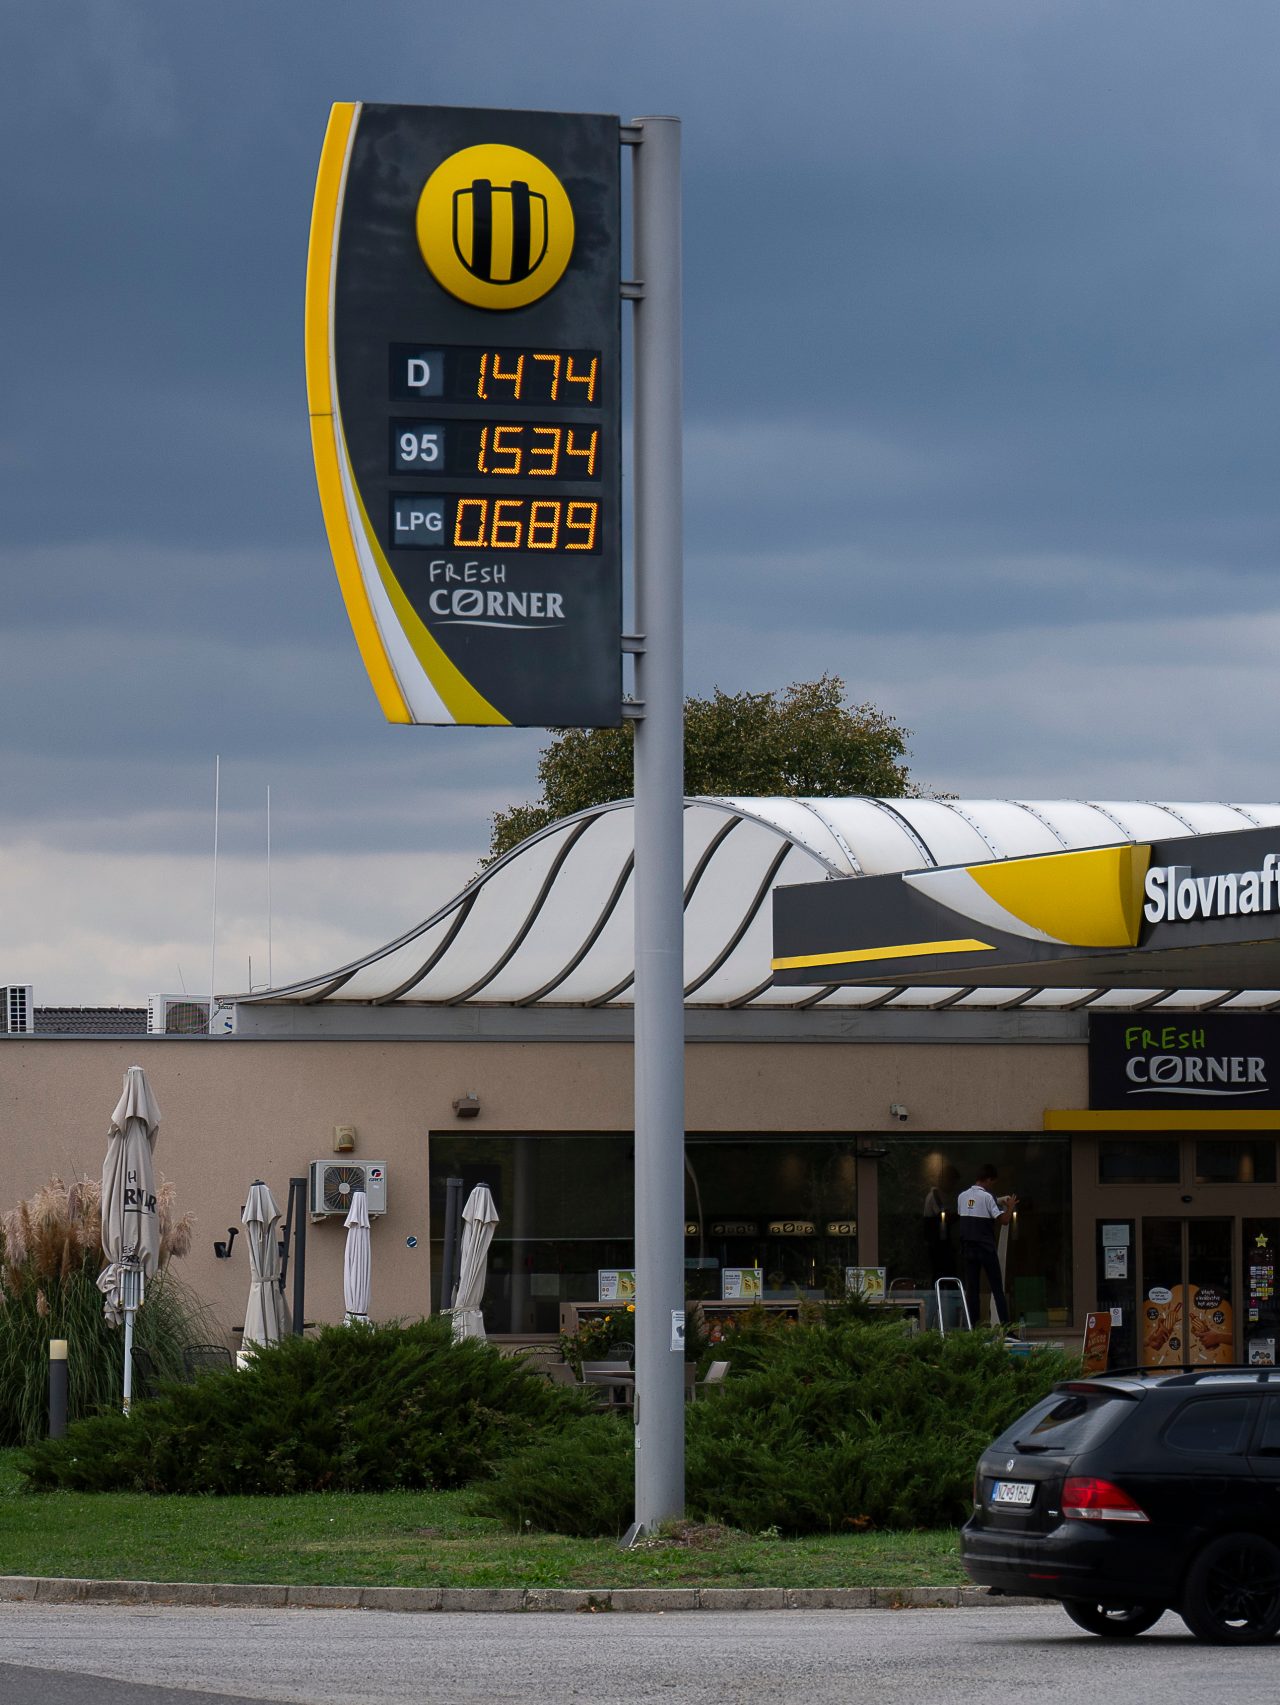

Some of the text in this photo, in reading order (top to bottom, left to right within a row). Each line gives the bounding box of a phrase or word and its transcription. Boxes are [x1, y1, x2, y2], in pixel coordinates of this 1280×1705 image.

[407, 353, 598, 402] D 1.474
[400, 426, 598, 476] 95 1.534
[395, 499, 598, 550] LPG 0.689
[429, 560, 506, 584] FRESH
[429, 589, 566, 618] CORNER
[1125, 1026, 1206, 1050] FRESH
[1126, 1055, 1268, 1084] CORNER
